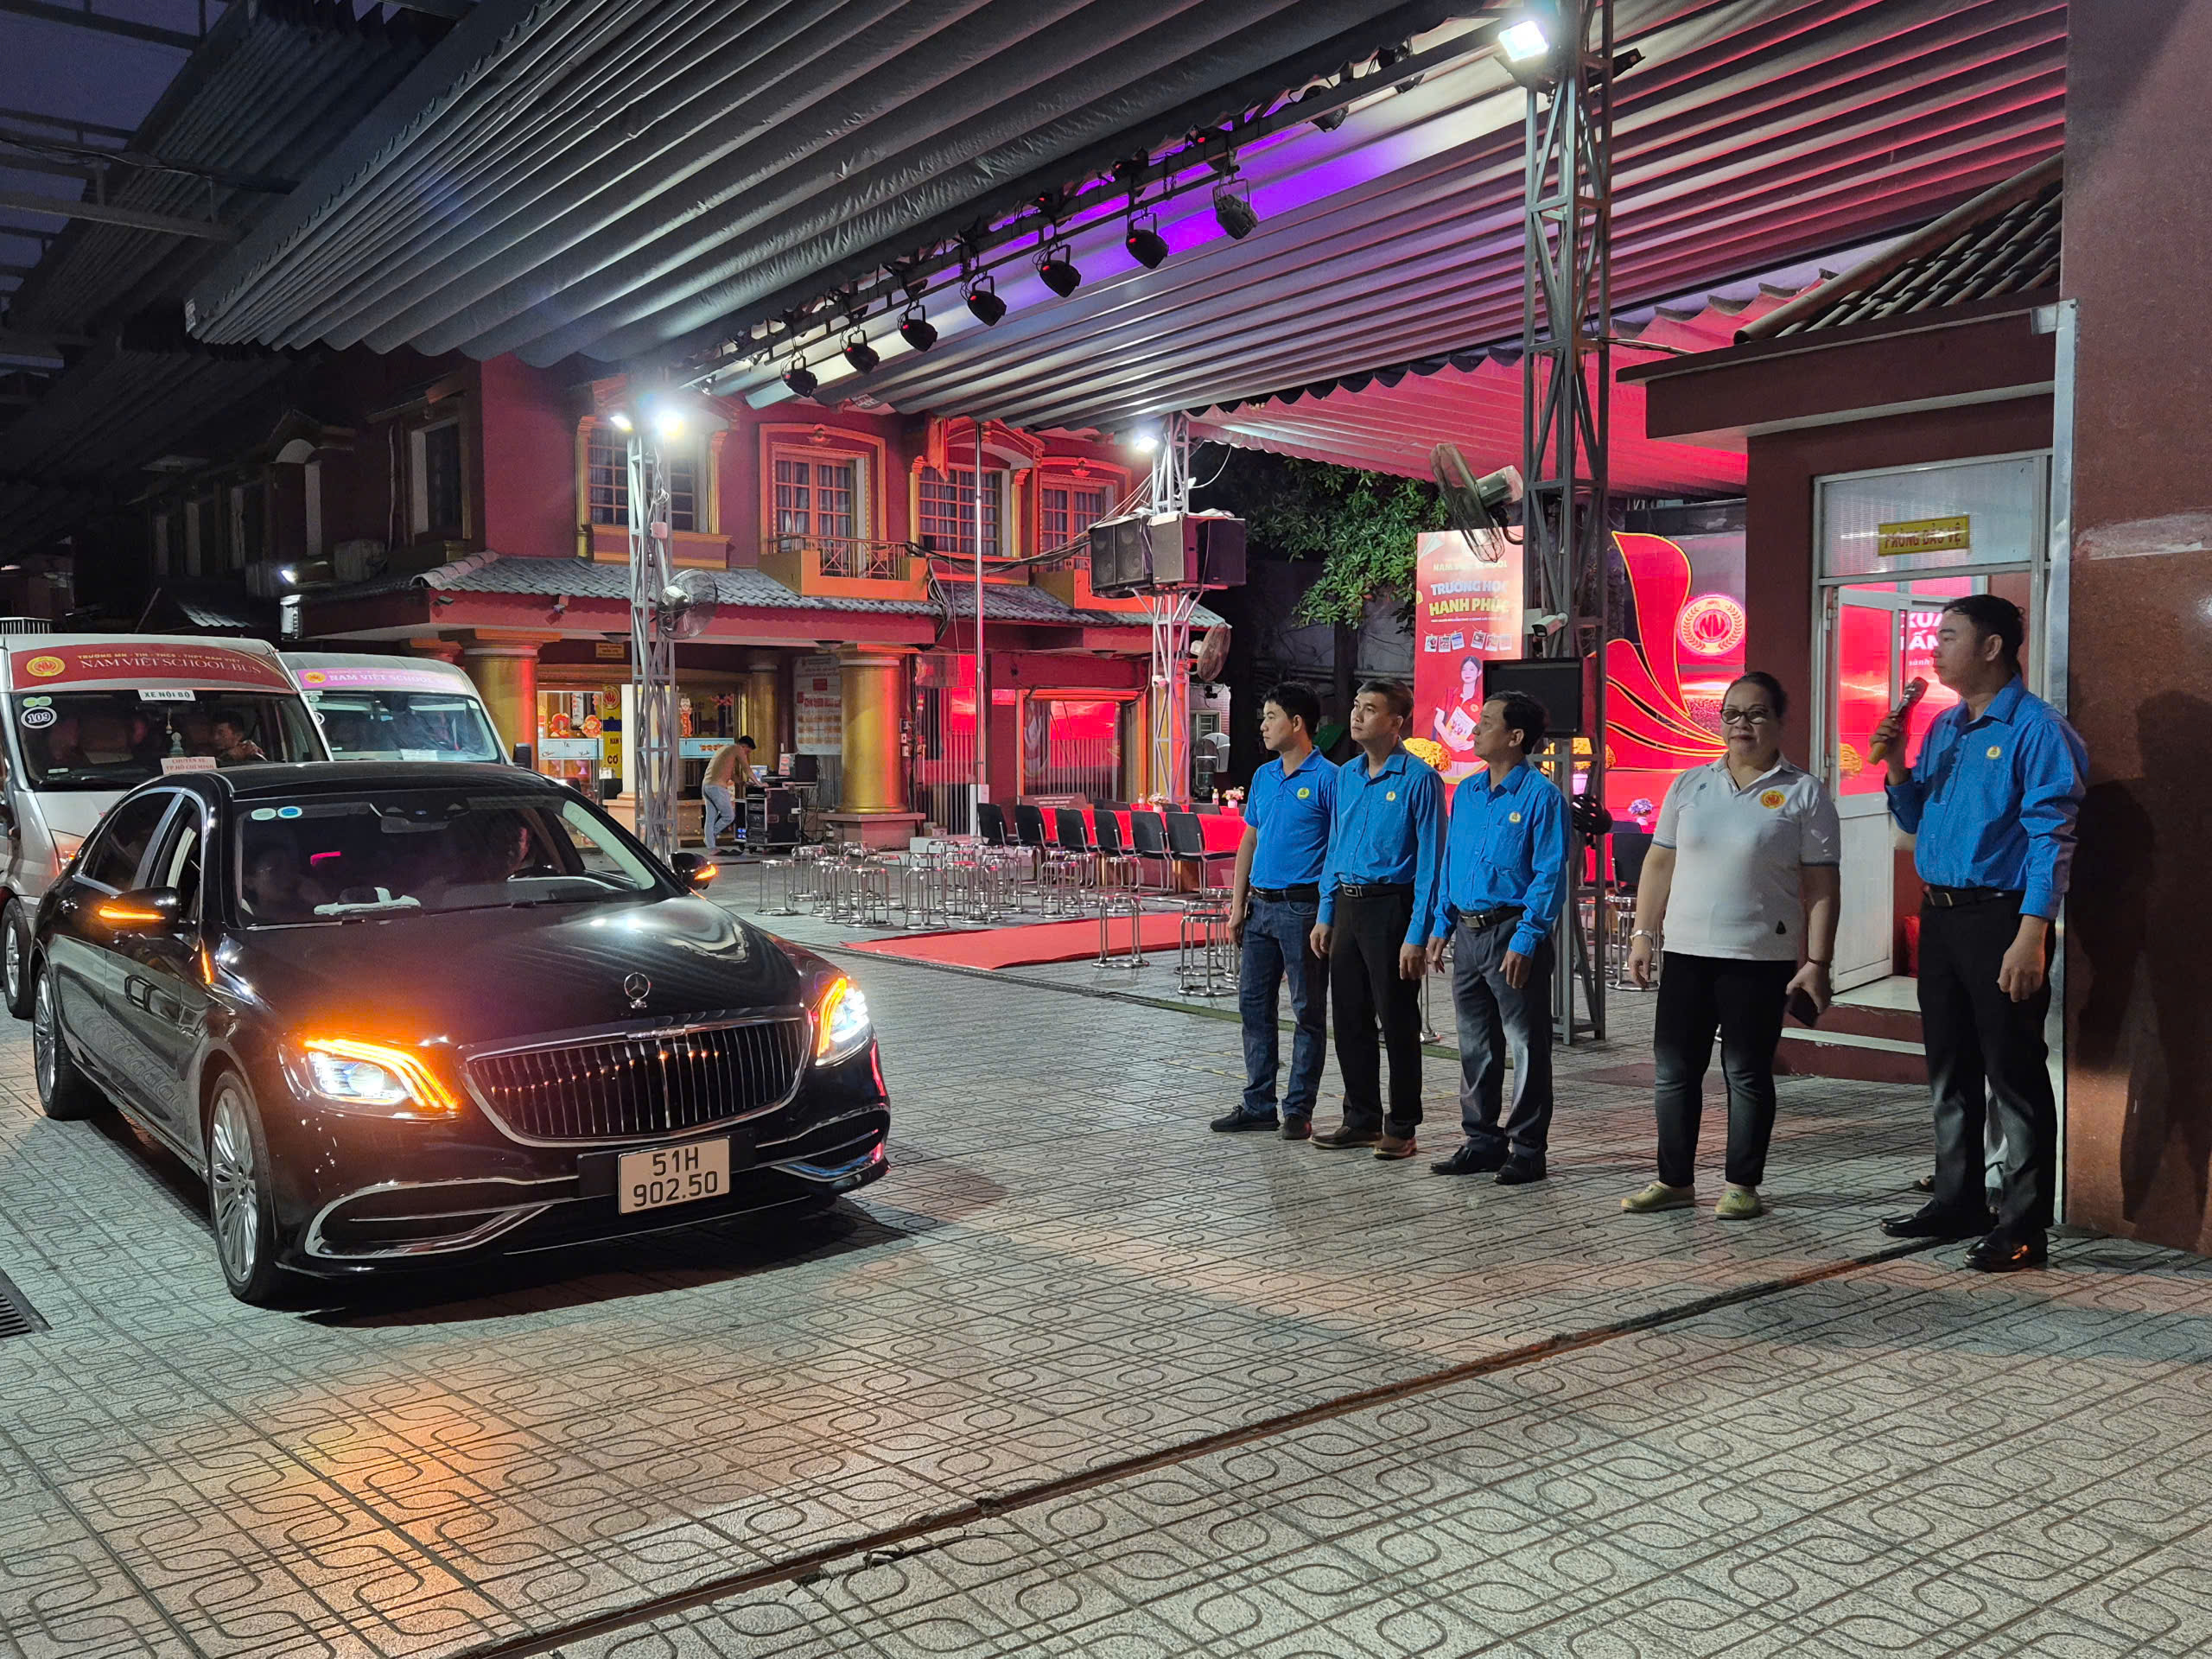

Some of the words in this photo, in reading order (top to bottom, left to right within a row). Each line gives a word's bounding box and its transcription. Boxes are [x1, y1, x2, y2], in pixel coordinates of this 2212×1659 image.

[79, 659, 119, 669] NAM
[162, 658, 228, 671] SCHOOL
[231, 662, 262, 675] BUS
[27, 711, 51, 724] 109
[652, 1147, 699, 1176] 51H
[633, 1171, 718, 1208] 902.50
